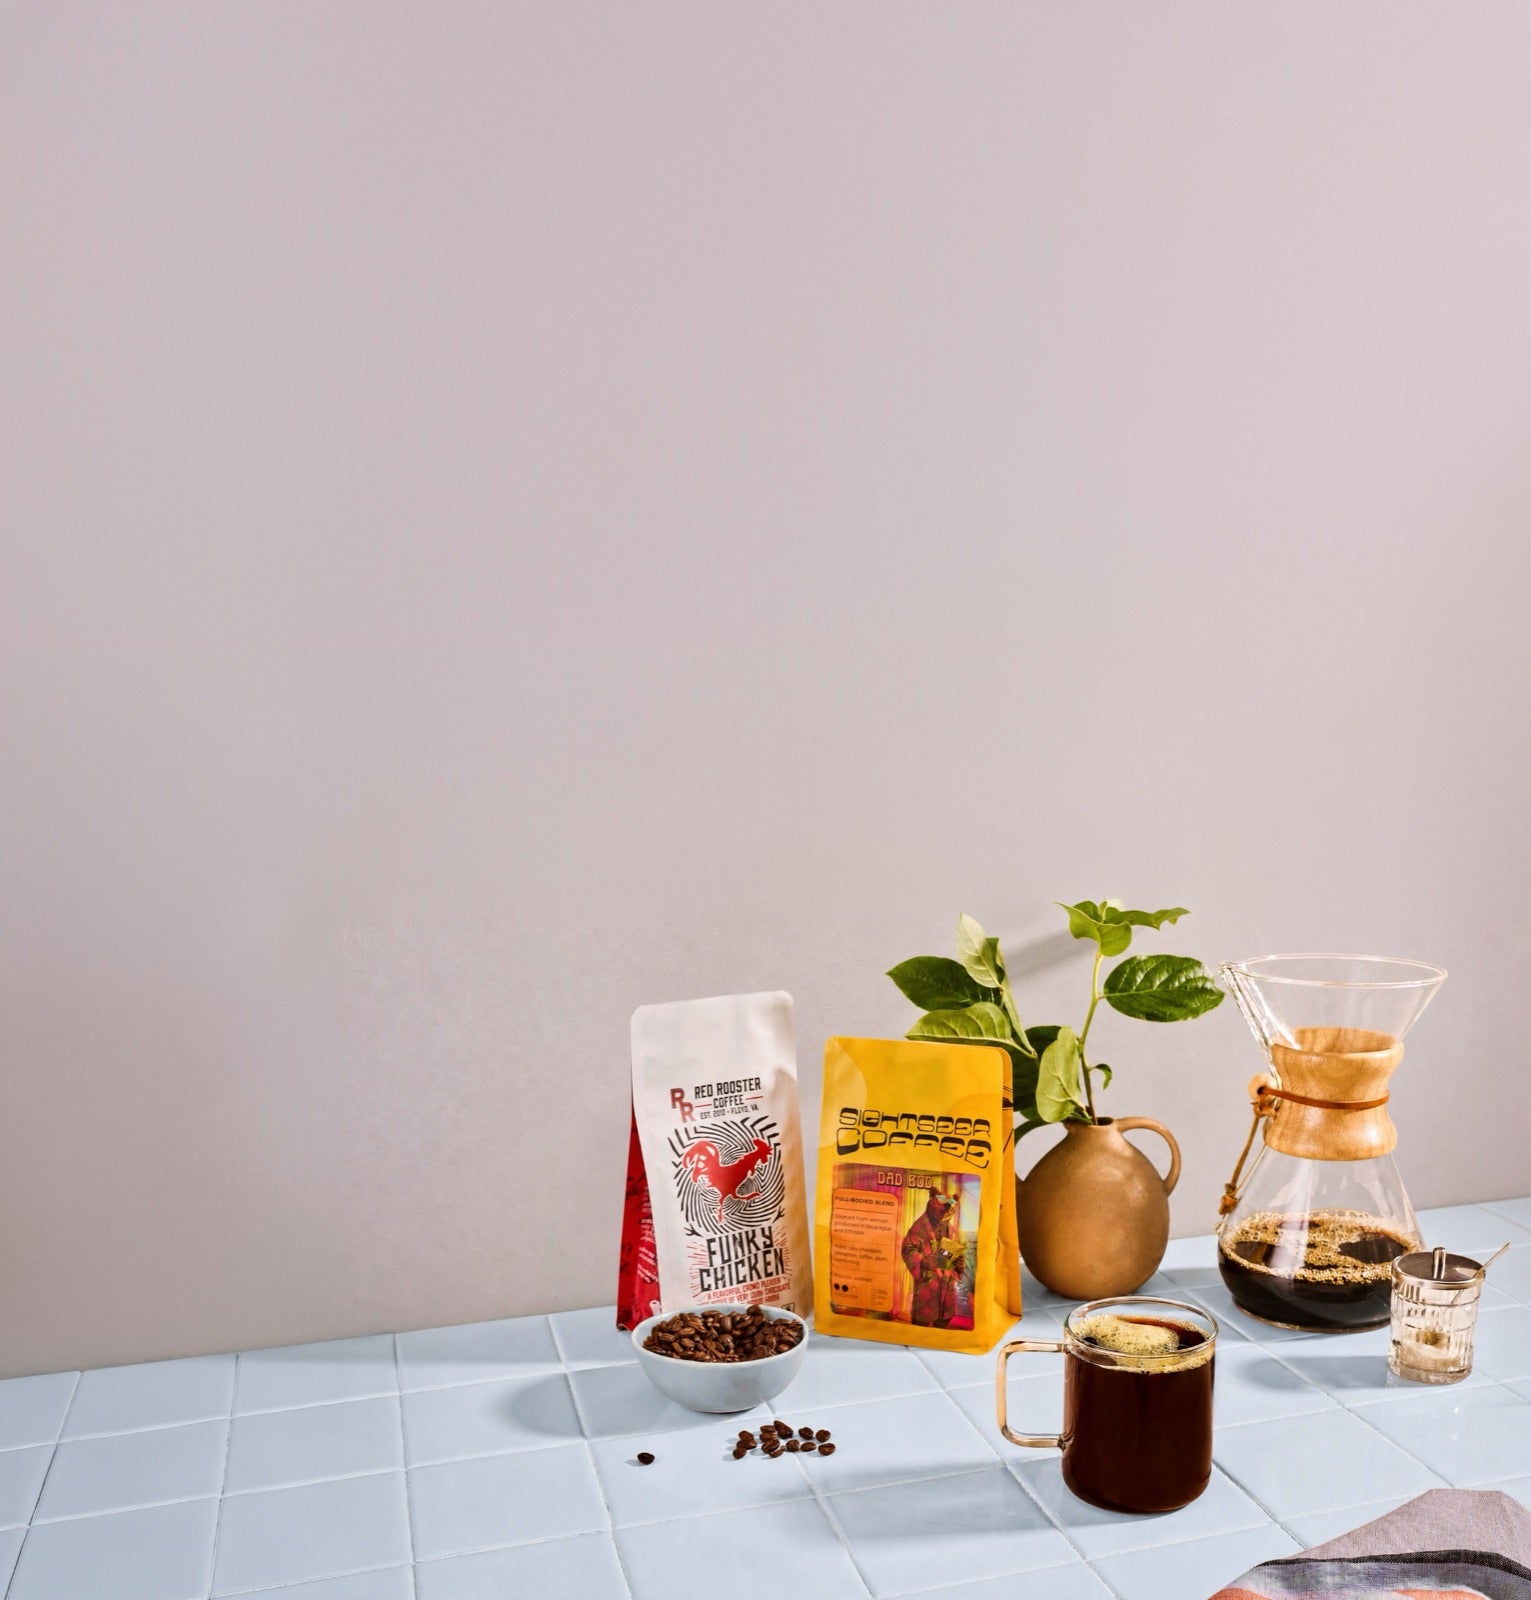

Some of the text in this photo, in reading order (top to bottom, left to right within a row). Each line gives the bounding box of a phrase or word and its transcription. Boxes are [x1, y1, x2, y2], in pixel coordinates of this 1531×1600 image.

[694, 1077, 762, 1099] RED ROOSTER
[713, 1094, 744, 1109] COFFEE
[700, 1112, 712, 1120] EST.
[713, 1109, 726, 1118] 2010
[839, 1107, 991, 1138] SIGHTSEER
[836, 1127, 992, 1169] COFFEE
[877, 1171, 933, 1189] DAD BOD
[875, 1199, 895, 1207] BLEND
[706, 1225, 774, 1267] FUNKY
[699, 1248, 785, 1292] CHICKEN
